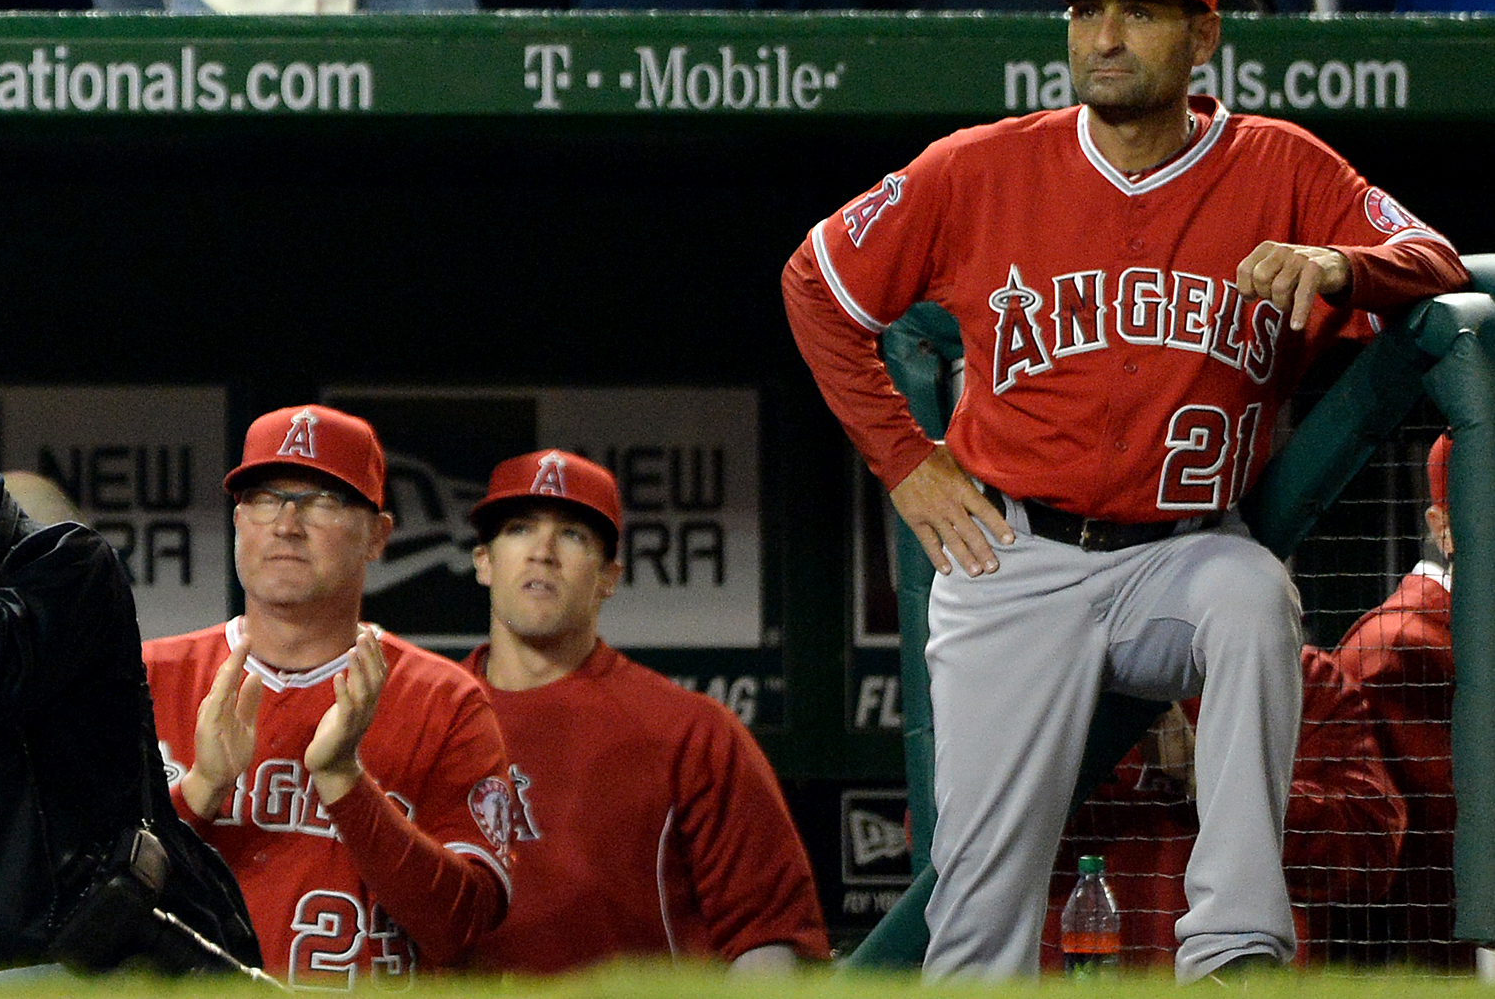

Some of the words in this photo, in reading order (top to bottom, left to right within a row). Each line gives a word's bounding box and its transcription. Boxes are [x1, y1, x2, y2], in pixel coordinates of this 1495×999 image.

[1005, 45, 1406, 110] naals.com
[842, 172, 907, 249] A
[988, 263, 1284, 396] ANGELS
[276, 408, 318, 459] A
[1156, 402, 1263, 512] 21
[38, 446, 192, 513] NEW
[530, 450, 566, 497] A
[604, 447, 725, 513] EW
[94, 518, 192, 587] RA
[622, 518, 727, 587] RA
